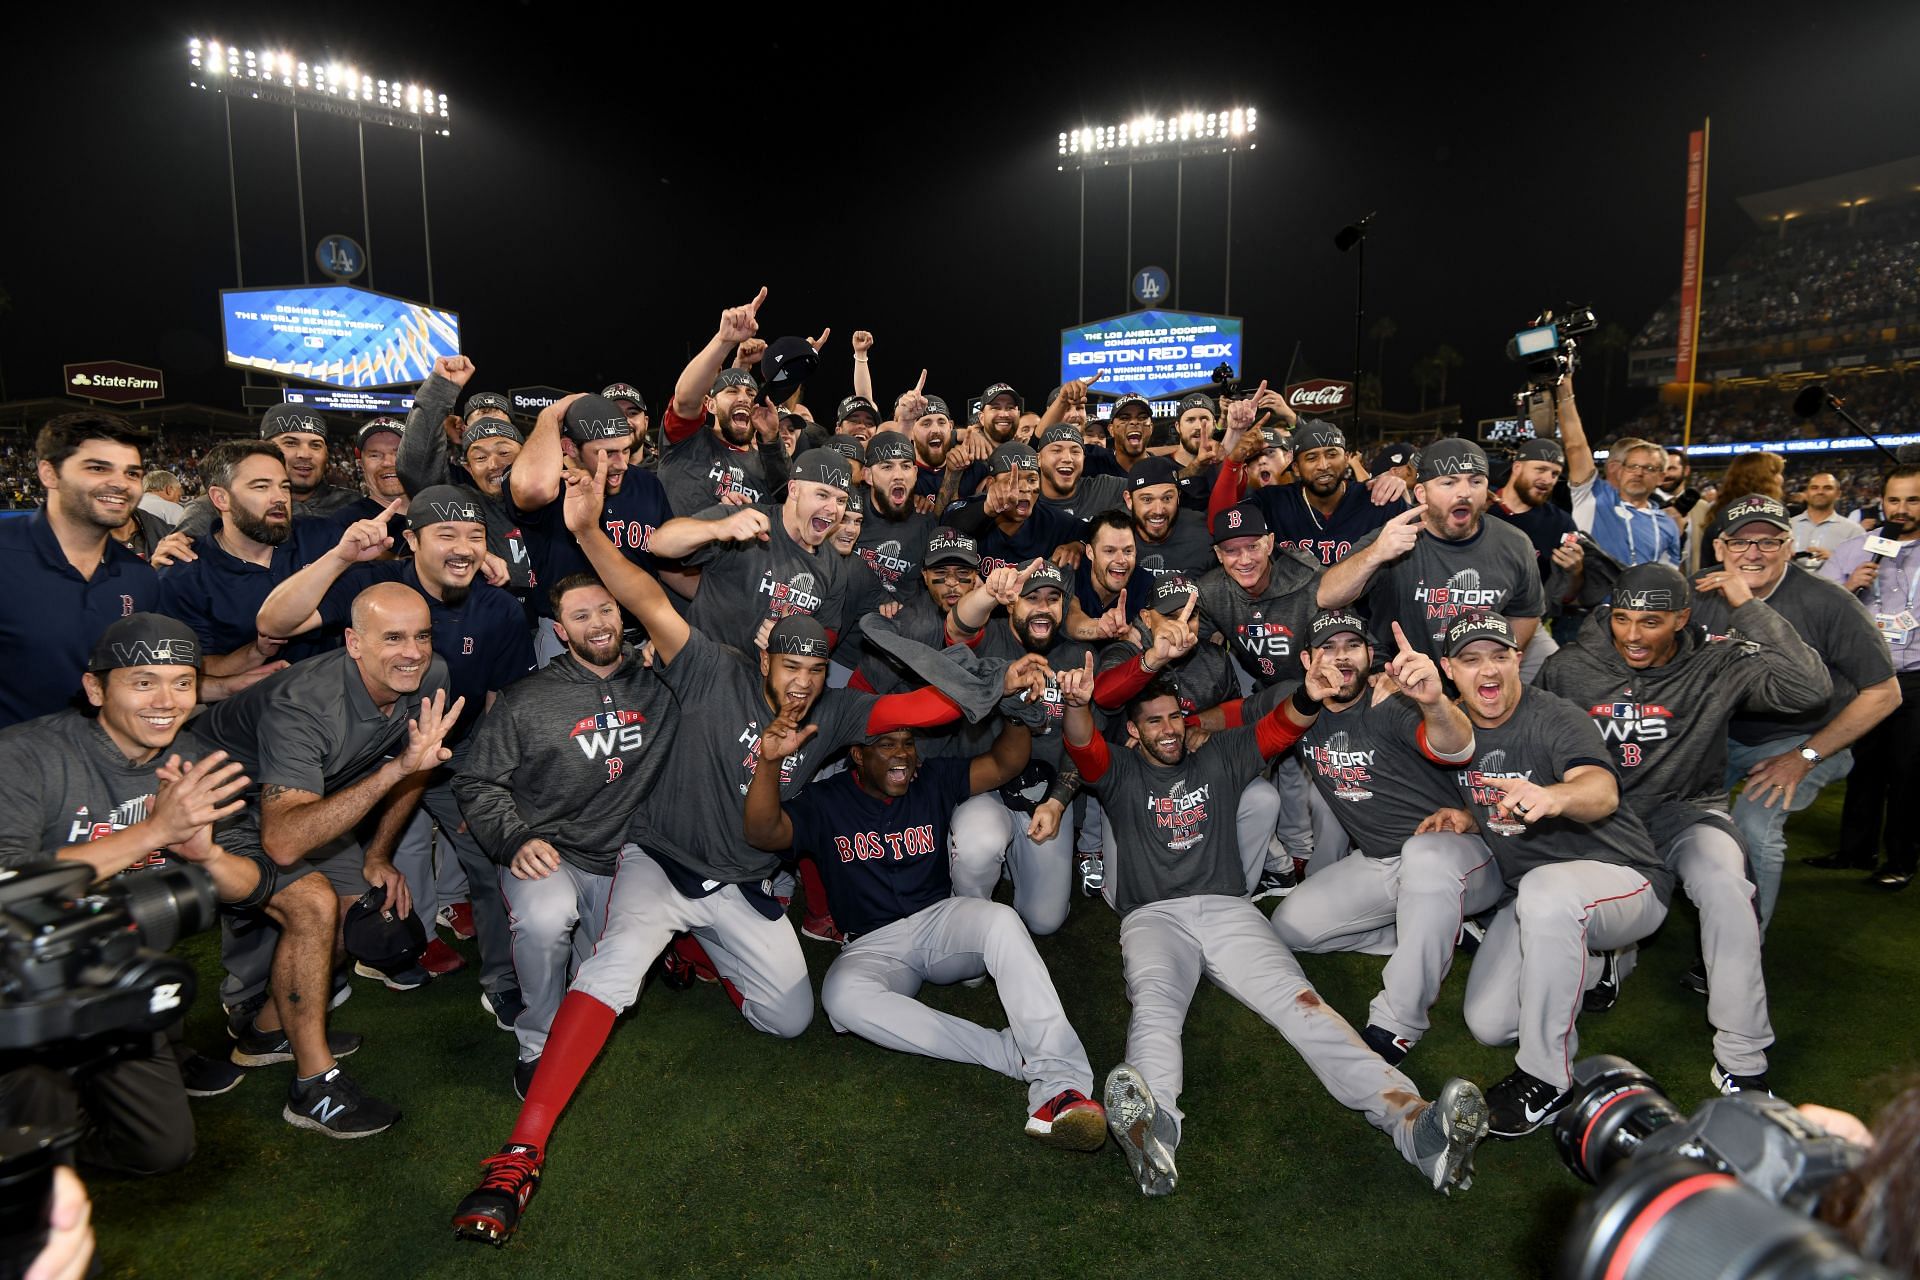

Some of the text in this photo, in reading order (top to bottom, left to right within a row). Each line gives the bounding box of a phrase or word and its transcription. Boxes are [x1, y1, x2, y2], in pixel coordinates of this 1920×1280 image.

[1141, 272, 1159, 298] LA
[234, 311, 385, 331] THE WORLD SERIES TROPHY
[273, 323, 352, 337] PRESENTATION
[1084, 325, 1217, 341] THE LOS ANGELES DODGERS
[1104, 334, 1196, 347] CONGRATULATE THE
[1068, 343, 1232, 365] BOSTON RED SOX
[1079, 370, 1214, 383] WLD SERIES CHAMPIONSH
[1113, 366, 1153, 374] WINNING
[1154, 364, 1174, 372] THE
[1176, 363, 1201, 371] 2018
[1289, 384, 1347, 406] Coca-Cola
[277, 414, 328, 437] WS
[579, 416, 633, 440] WS
[874, 442, 913, 460] WS
[1762, 443, 1785, 452] THE
[1787, 440, 1829, 450] WORLD
[1830, 438, 1873, 448] SERIES
[1434, 453, 1488, 476] WS
[1227, 510, 1243, 529] B
[1727, 504, 1784, 520] CHAMPS
[606, 519, 657, 553] TON
[930, 540, 973, 551] CHAMPS
[1031, 569, 1062, 581] AMPS
[120, 594, 134, 617] B
[1613, 588, 1673, 611] WS
[1313, 616, 1362, 632] CHAMPS
[1451, 621, 1507, 641] CHAMPS
[112, 638, 194, 668] WS
[462, 637, 475, 655] B
[780, 633, 829, 659] WS
[1238, 635, 1290, 656] WS
[1257, 657, 1276, 676] B
[579, 720, 593, 728] 20
[1593, 718, 1668, 742] WS
[575, 725, 643, 760] WS
[1619, 743, 1642, 767] B
[605, 757, 624, 784] B
[1316, 762, 1371, 781] MADE
[1471, 787, 1510, 806] MAD
[1156, 804, 1208, 829] MADE
[834, 824, 936, 863] BOSTON
